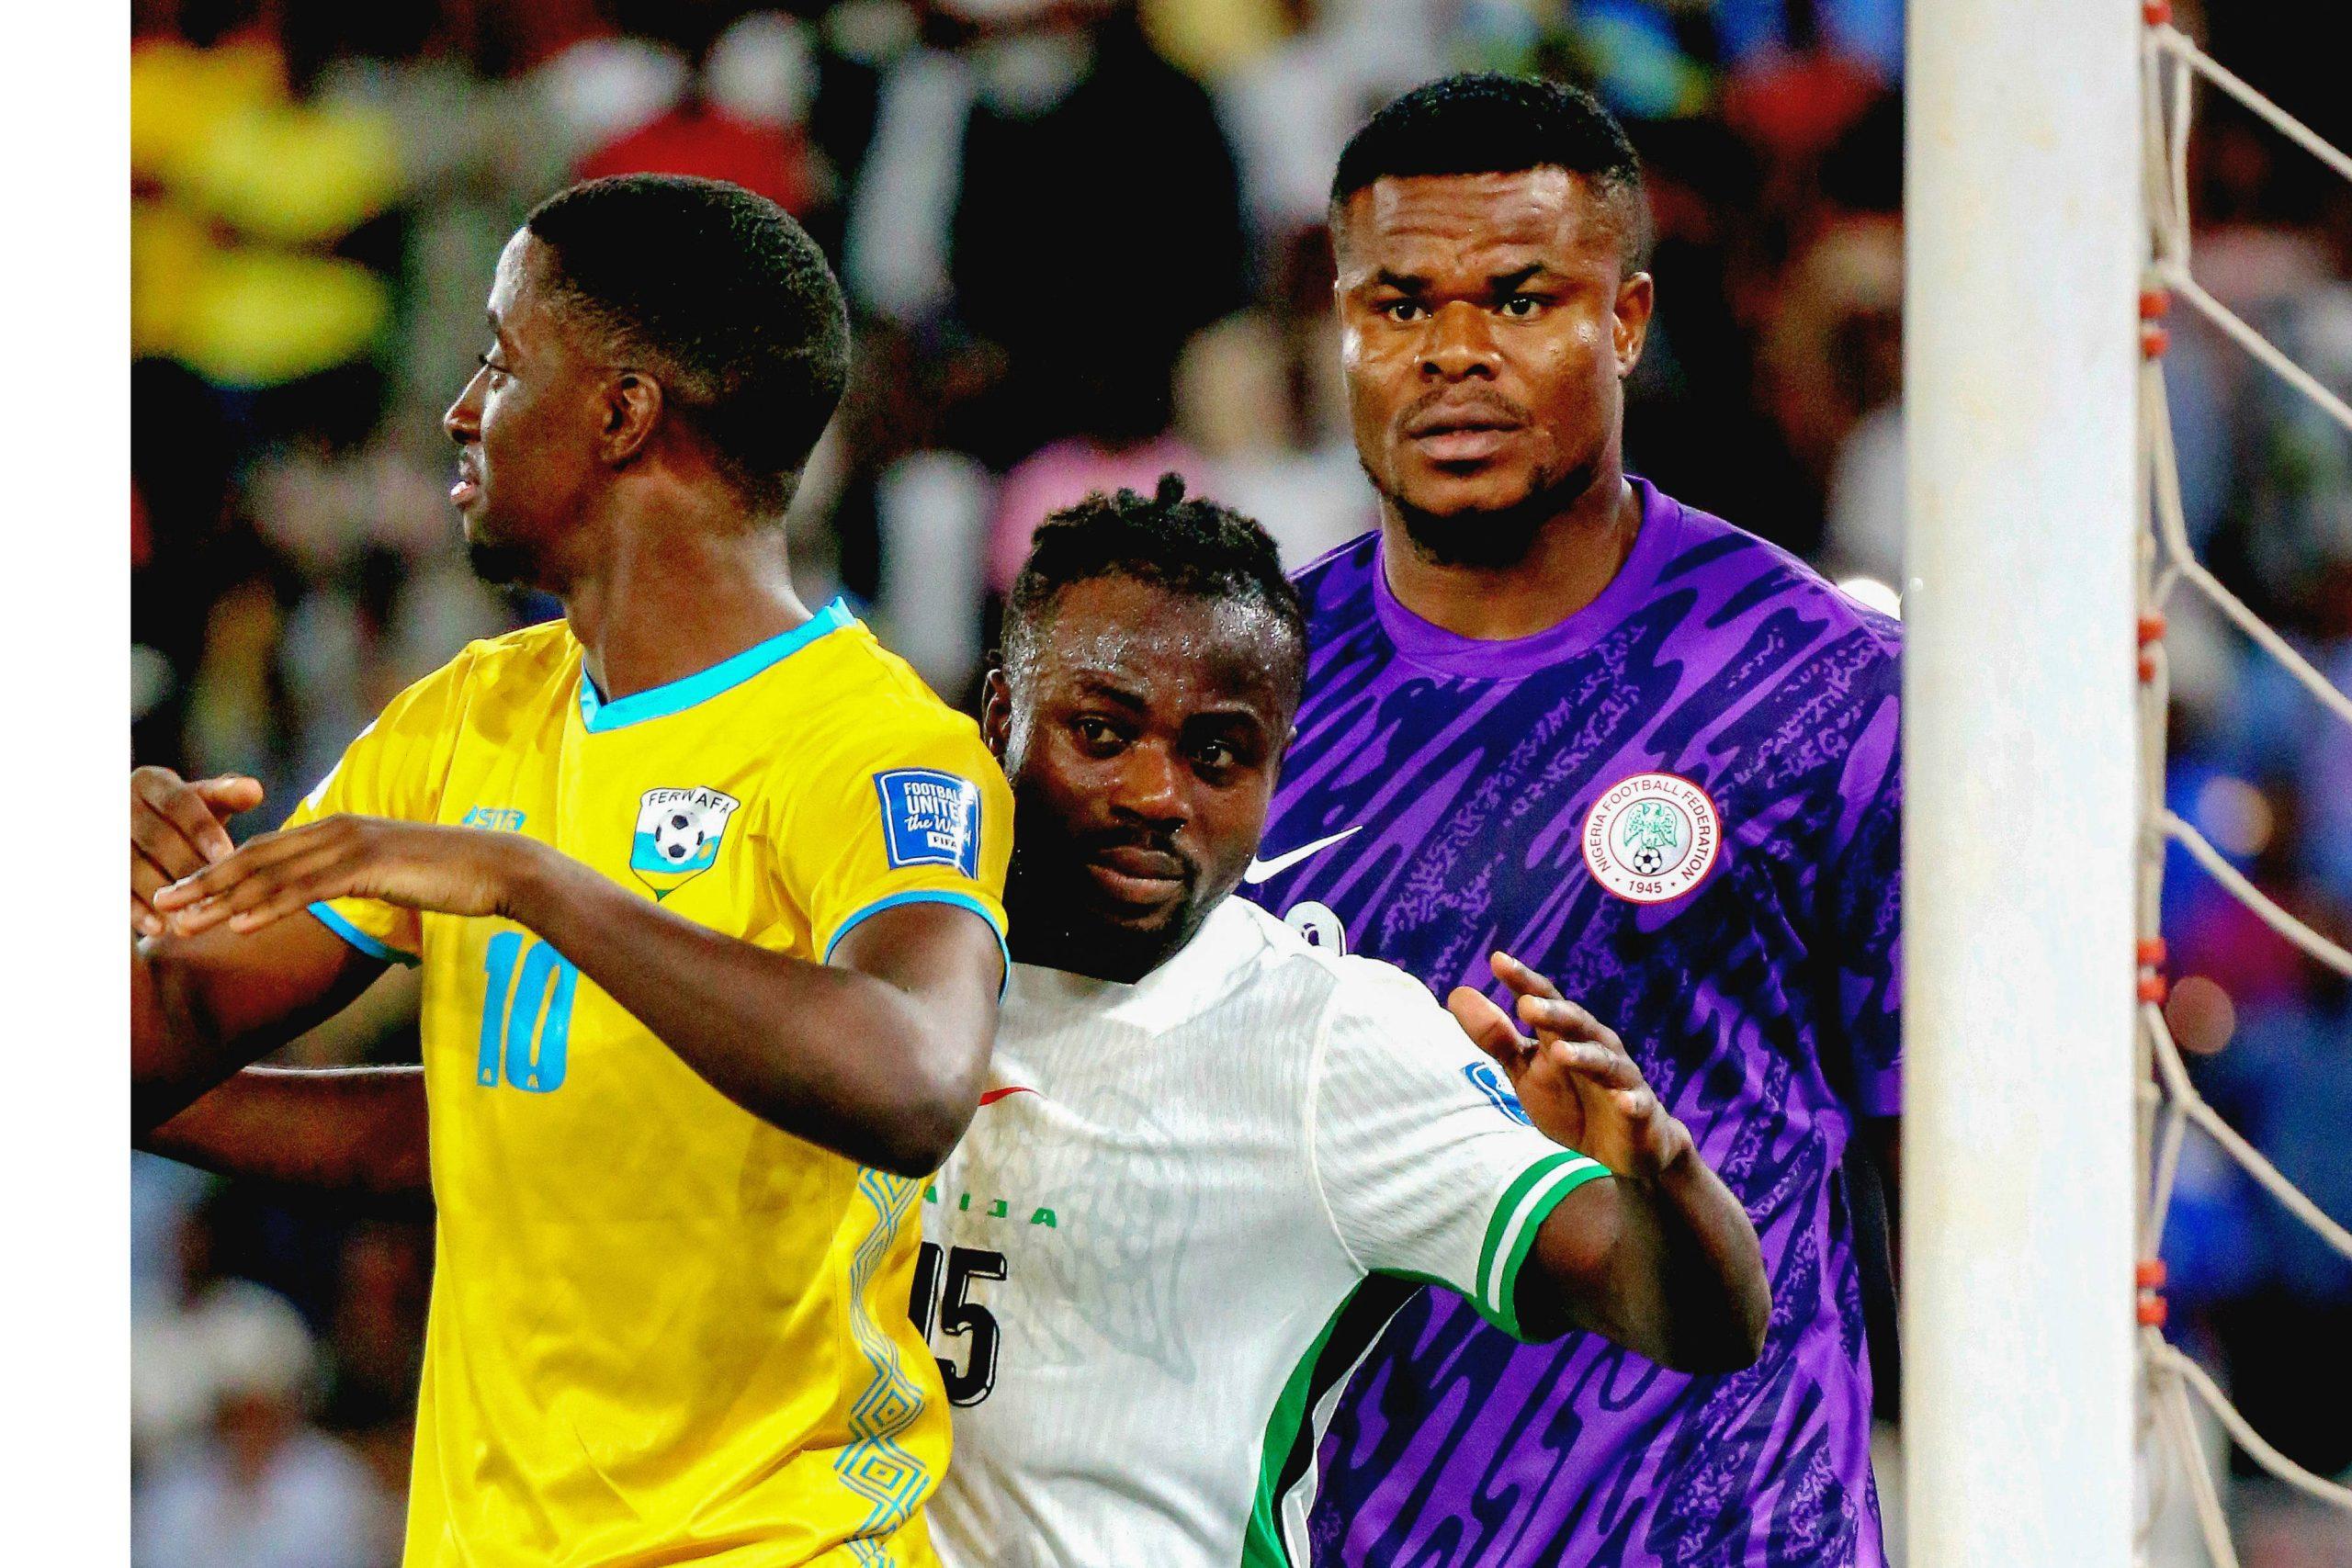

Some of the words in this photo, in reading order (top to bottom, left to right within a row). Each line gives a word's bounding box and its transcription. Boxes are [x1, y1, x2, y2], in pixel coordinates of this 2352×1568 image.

[649, 789, 731, 814] FERWAFA
[903, 782, 962, 806] FOOTBAL
[904, 814, 933, 832] the
[906, 795, 962, 824] UNITE
[1590, 814, 1611, 873] NIGERIA
[1602, 779, 1679, 812] FOOTBALL
[1680, 790, 1711, 882] FEDERATION
[1629, 880, 1663, 895] 1945
[476, 931, 580, 1094] 10
[907, 1240, 1009, 1408] 15
